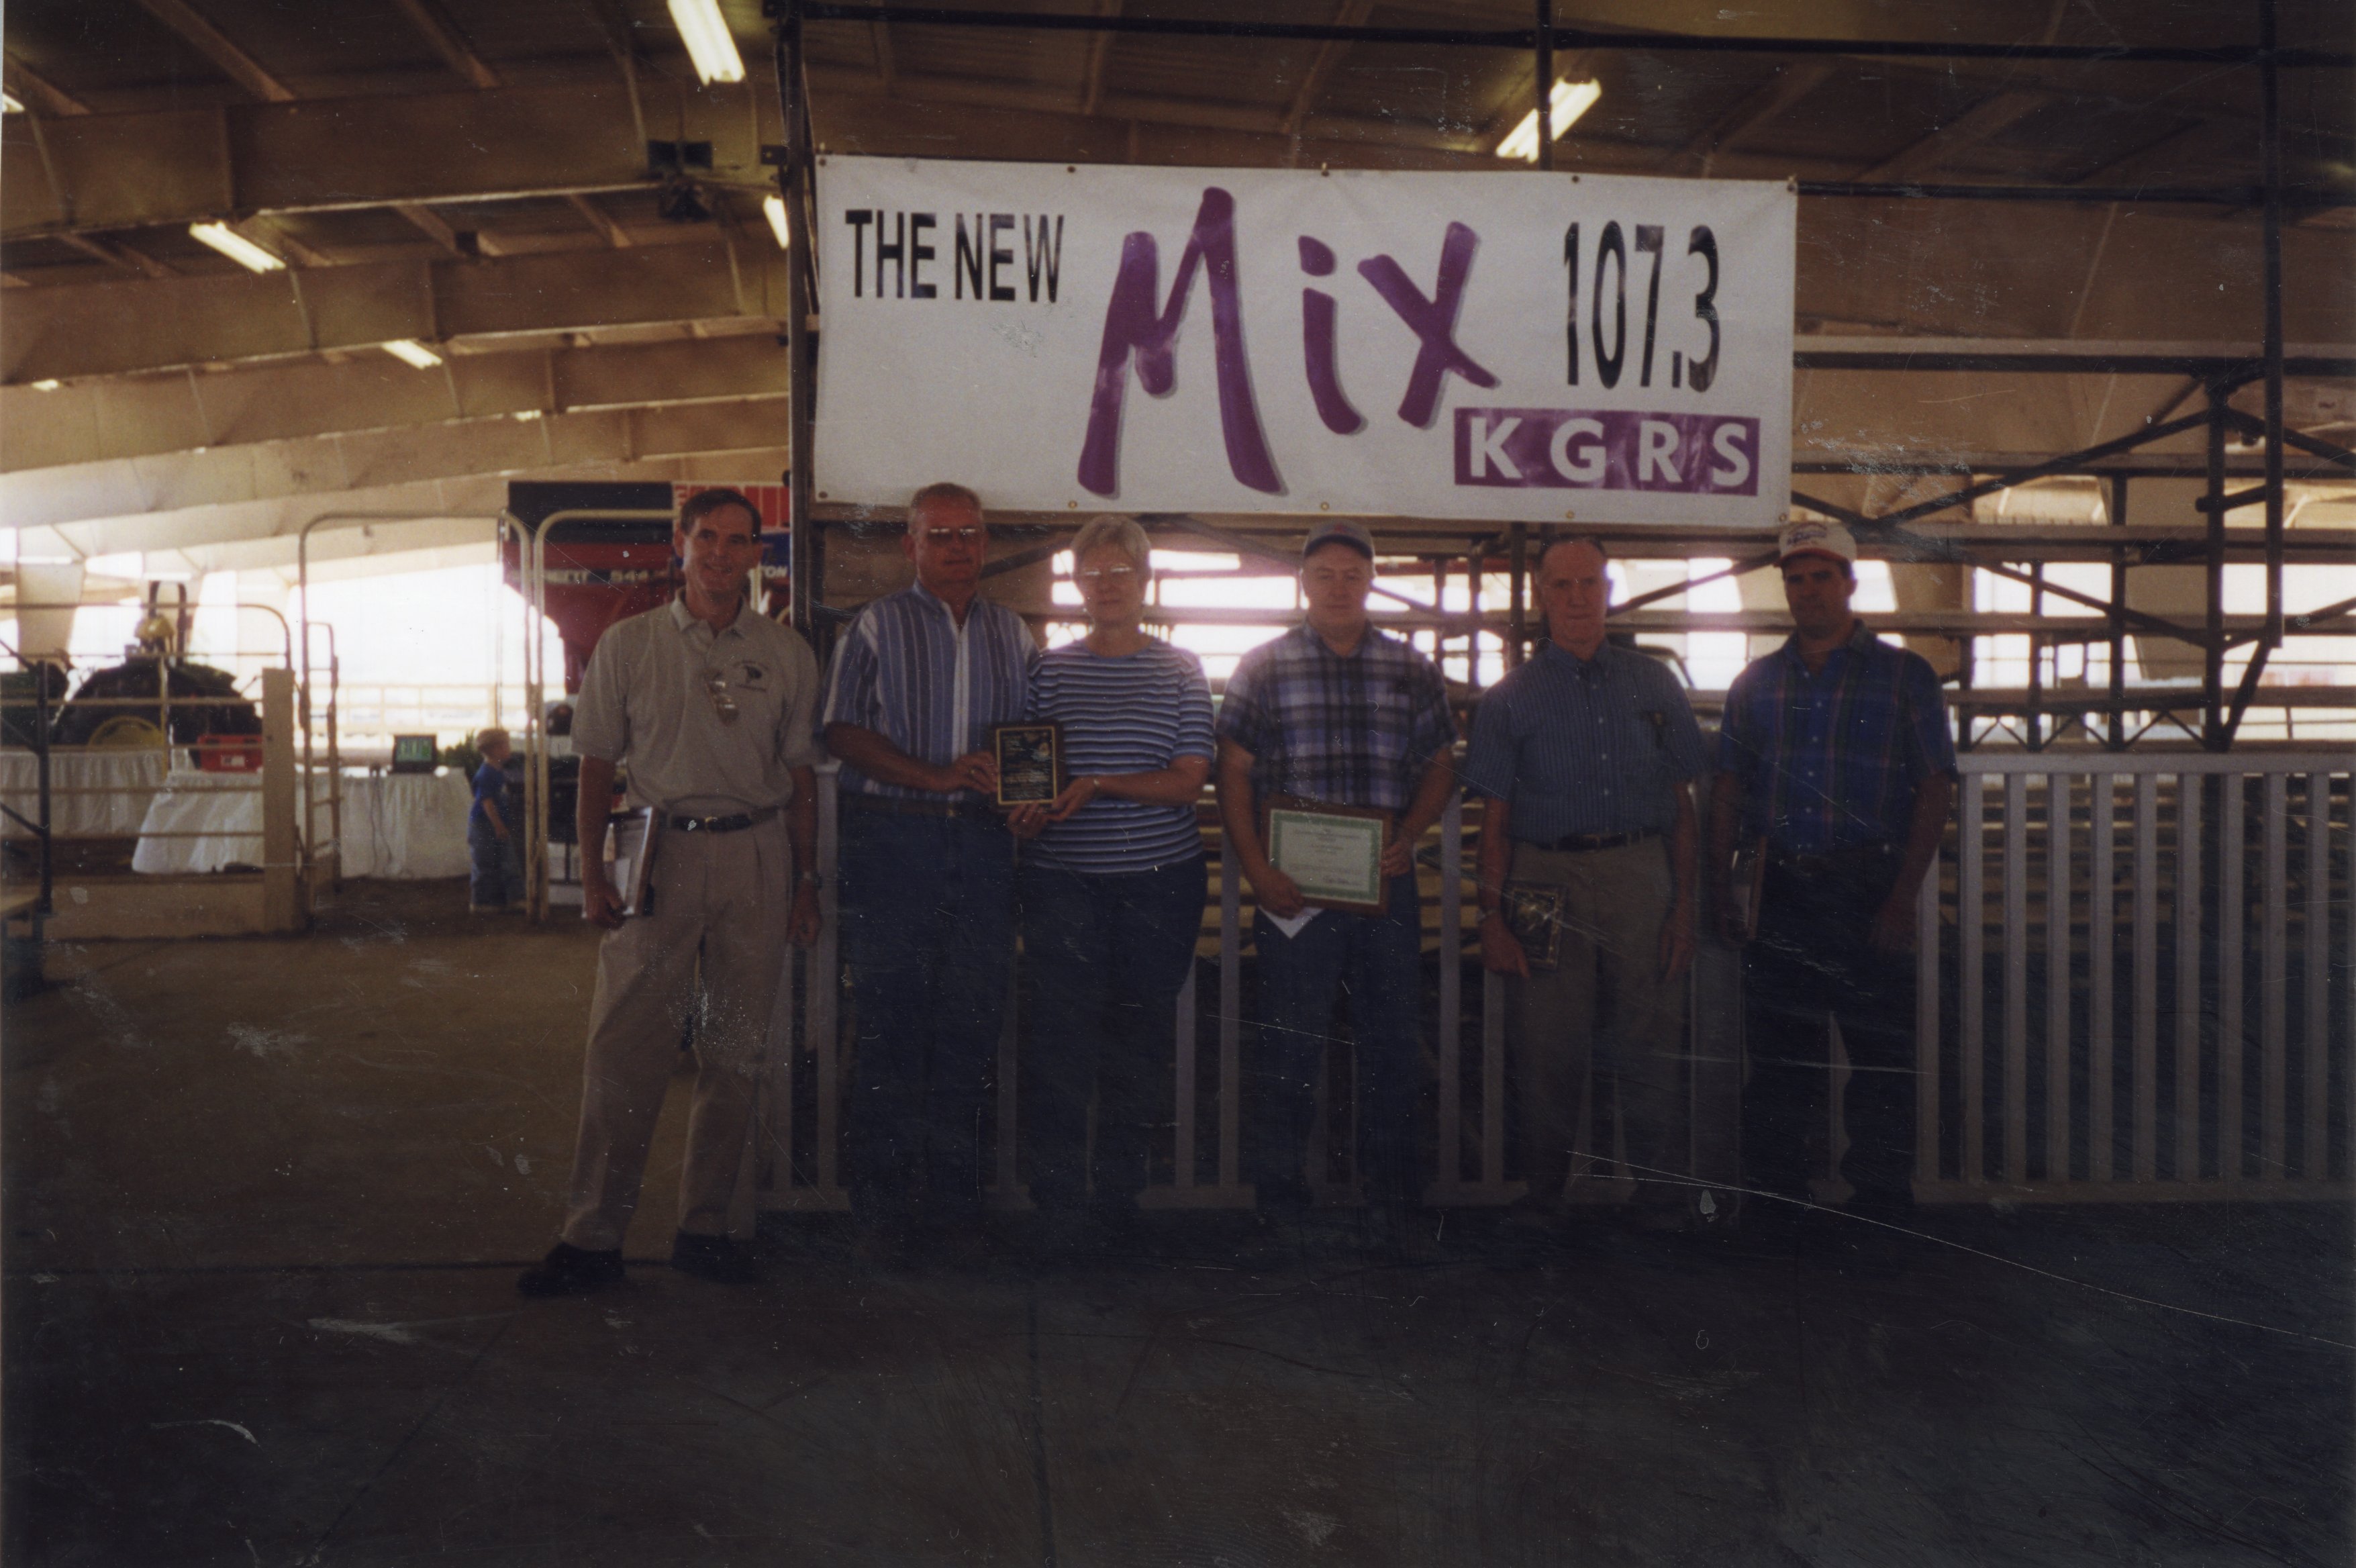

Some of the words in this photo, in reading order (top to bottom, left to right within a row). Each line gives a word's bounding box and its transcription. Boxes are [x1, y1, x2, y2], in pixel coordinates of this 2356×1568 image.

[844, 209, 937, 299] THE
[954, 213, 1064, 303] NEW
[1564, 220, 1720, 393] 107.3
[1078, 187, 1501, 497] Mix
[1471, 416, 1750, 487] KGRS
